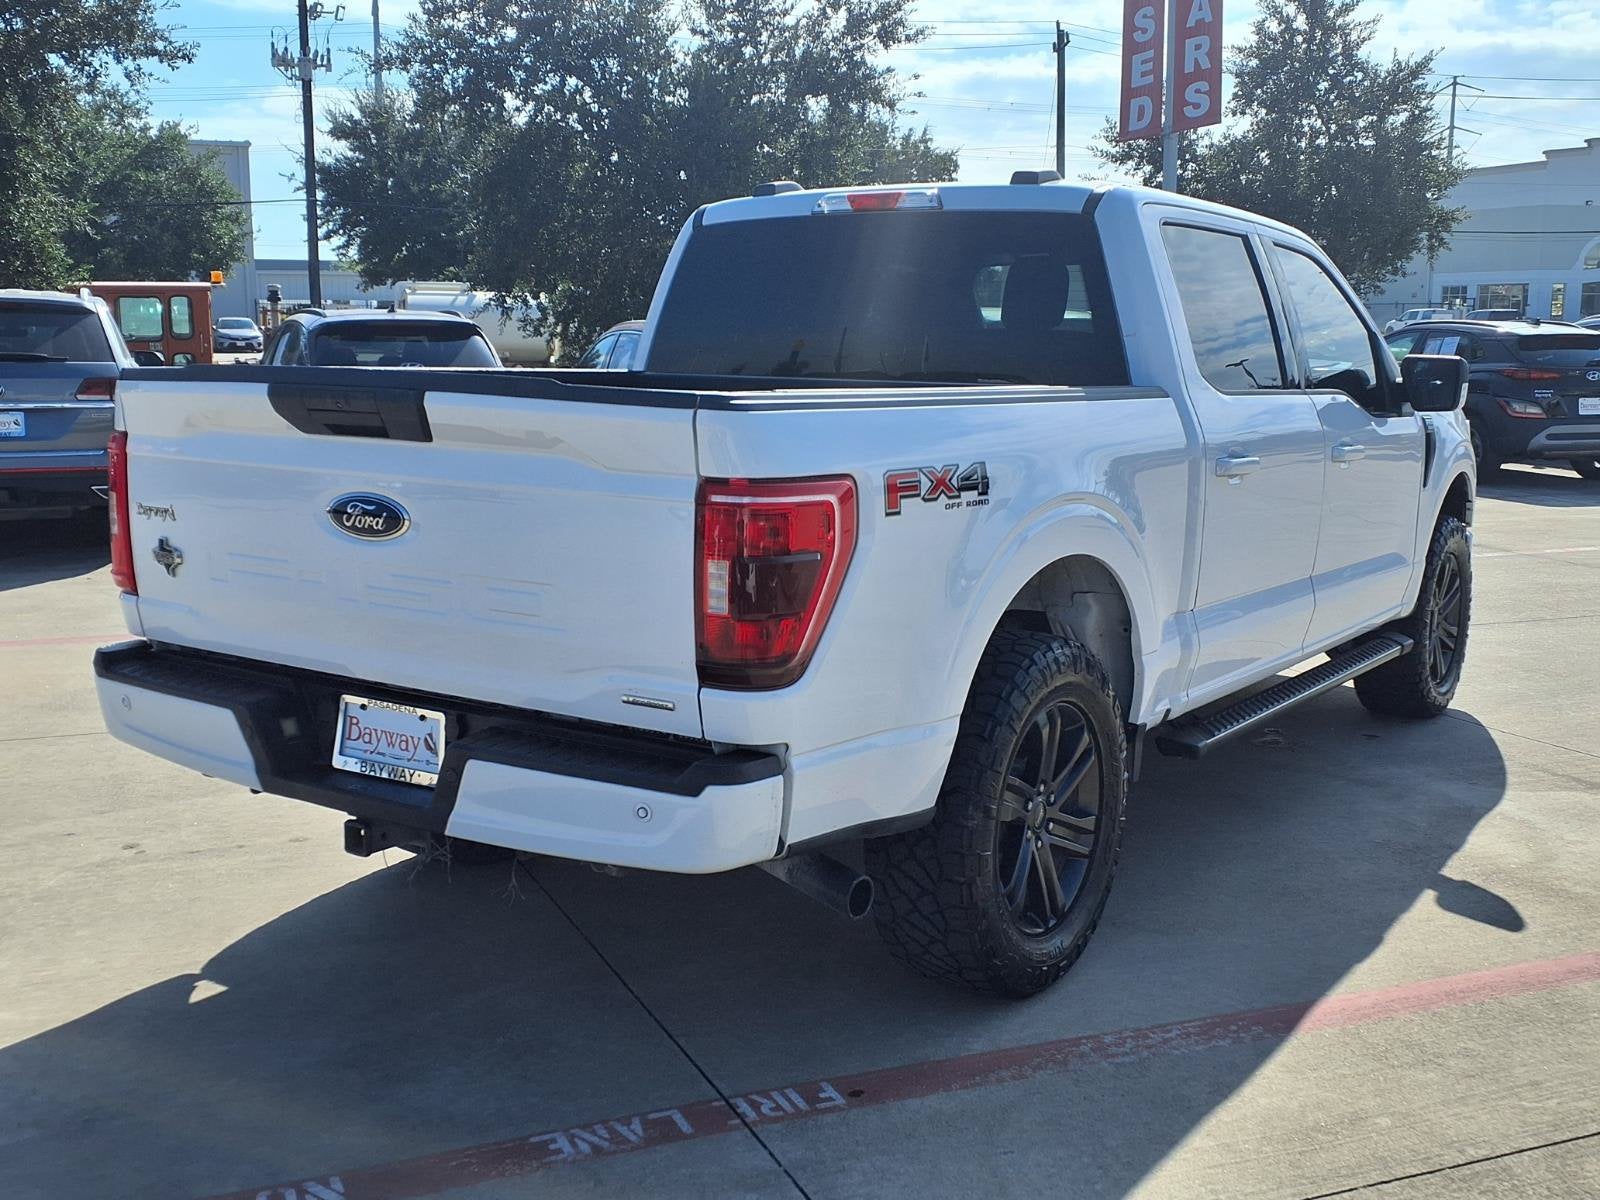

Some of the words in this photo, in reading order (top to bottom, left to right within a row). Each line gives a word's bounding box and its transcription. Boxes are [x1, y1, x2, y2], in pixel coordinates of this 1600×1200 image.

[883, 461, 990, 517] FX4
[944, 502, 963, 511] OFF
[965, 498, 990, 508] ROAD
[342, 501, 387, 531] Ford
[367, 699, 418, 715] PASADENA
[345, 714, 421, 762] Bayway
[359, 760, 416, 783] BAYWAY
[712, 1081, 846, 1125] FIRE
[528, 1108, 695, 1163] LANE
